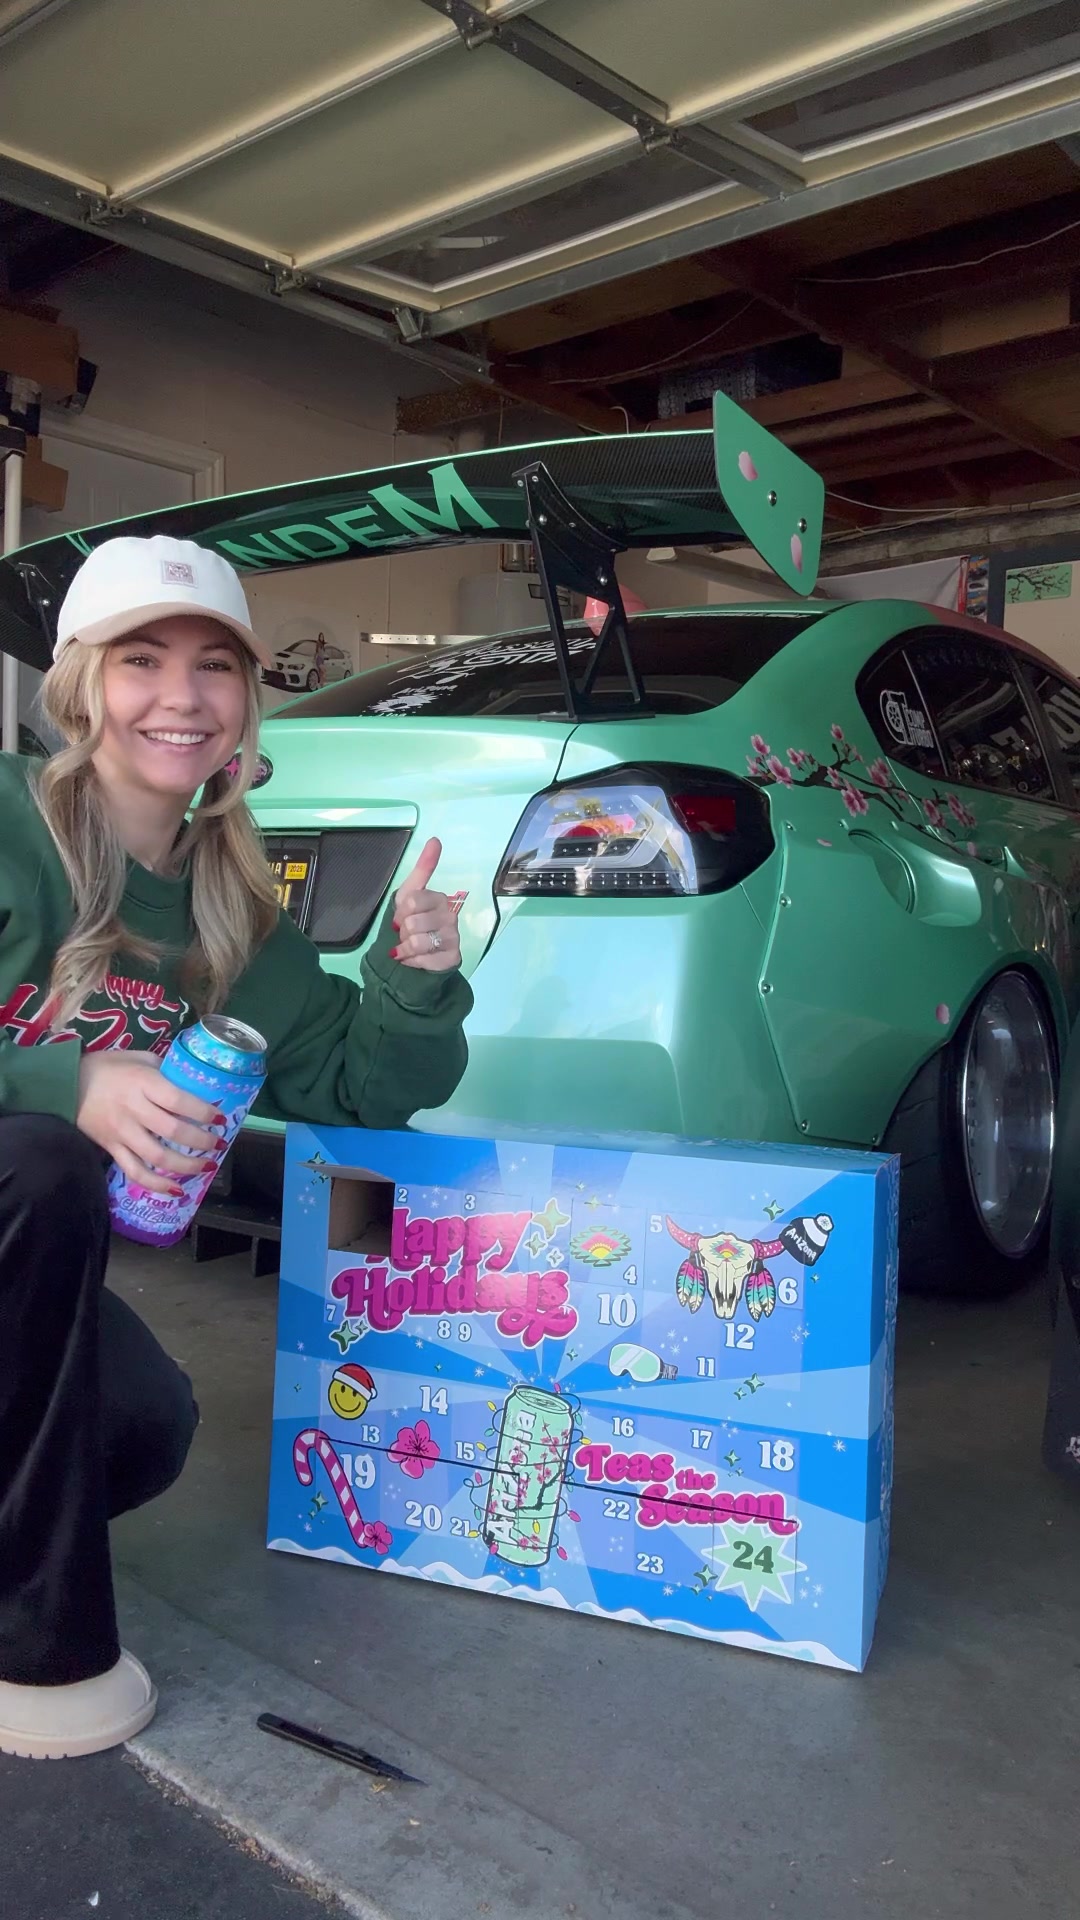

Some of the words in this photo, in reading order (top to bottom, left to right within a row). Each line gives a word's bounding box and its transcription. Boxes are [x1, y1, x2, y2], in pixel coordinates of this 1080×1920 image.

[65, 462, 499, 572] NDEM
[139, 1190, 174, 1210] Frost
[397, 1188, 408, 1203] 2
[465, 1194, 477, 1210] 3
[650, 1215, 663, 1233] 5
[623, 1265, 638, 1285] 4
[778, 1277, 798, 1305] 6
[325, 1304, 337, 1322] 7
[331, 1265, 578, 1348] Holidays
[598, 1293, 637, 1328] 10
[724, 1323, 756, 1350] 12
[696, 1357, 716, 1378] 11
[419, 1385, 449, 1415] 14
[361, 1424, 380, 1443] 13
[612, 1416, 635, 1437] 16
[690, 1429, 713, 1450] 17
[455, 1441, 475, 1461] 15
[758, 1439, 796, 1472] 18
[340, 1453, 377, 1489] 19
[574, 1444, 675, 1483] Teas
[674, 1468, 716, 1491] the
[405, 1500, 443, 1531] 20
[603, 1498, 631, 1520] 22
[636, 1483, 801, 1536] Season
[450, 1518, 471, 1537] 21
[636, 1552, 665, 1575] 23
[732, 1540, 774, 1575] 24
